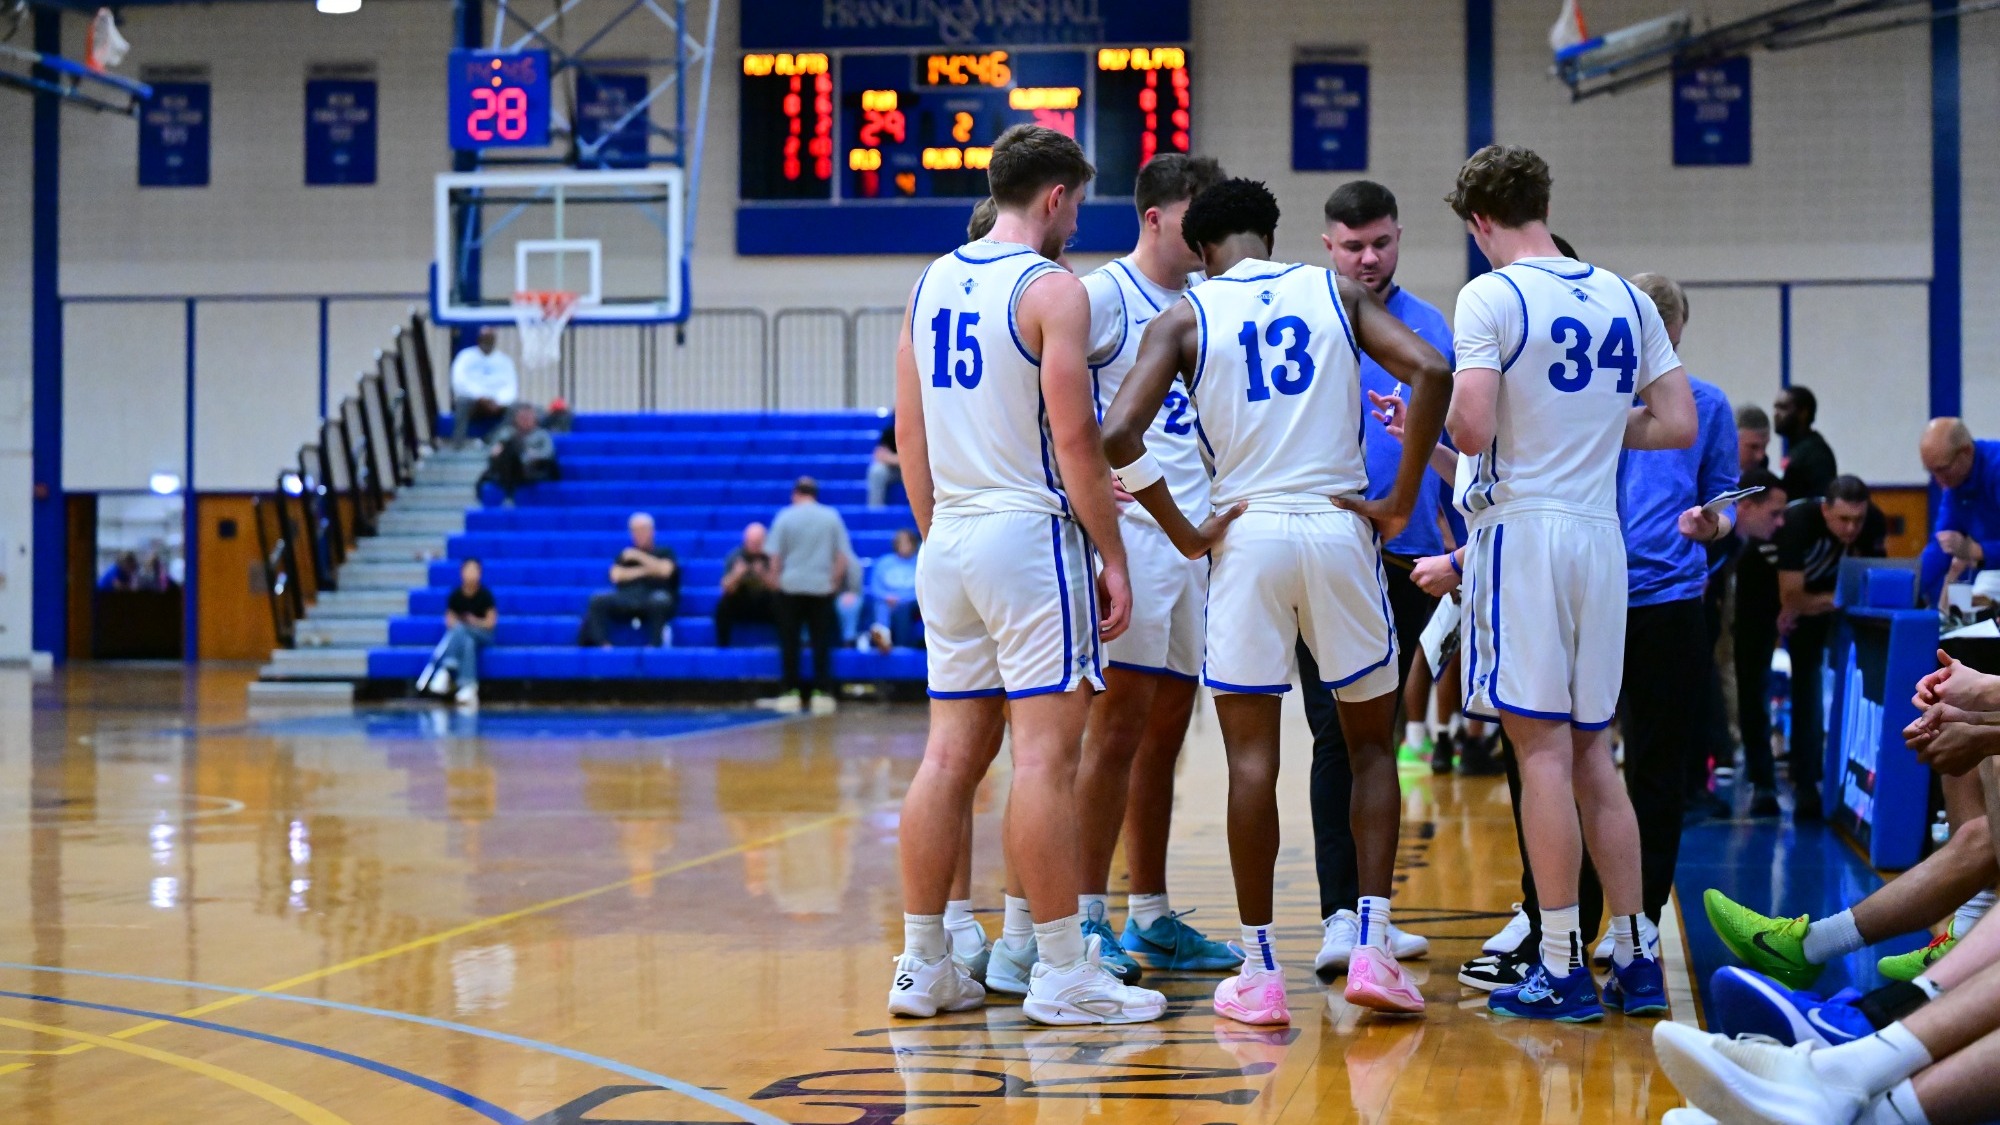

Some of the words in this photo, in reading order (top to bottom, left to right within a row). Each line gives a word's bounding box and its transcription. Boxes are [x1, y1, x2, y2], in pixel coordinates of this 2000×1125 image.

[467, 87, 528, 141] 28
[931, 307, 983, 390] 15
[1238, 315, 1315, 402] 13
[1548, 316, 1638, 394] 34
